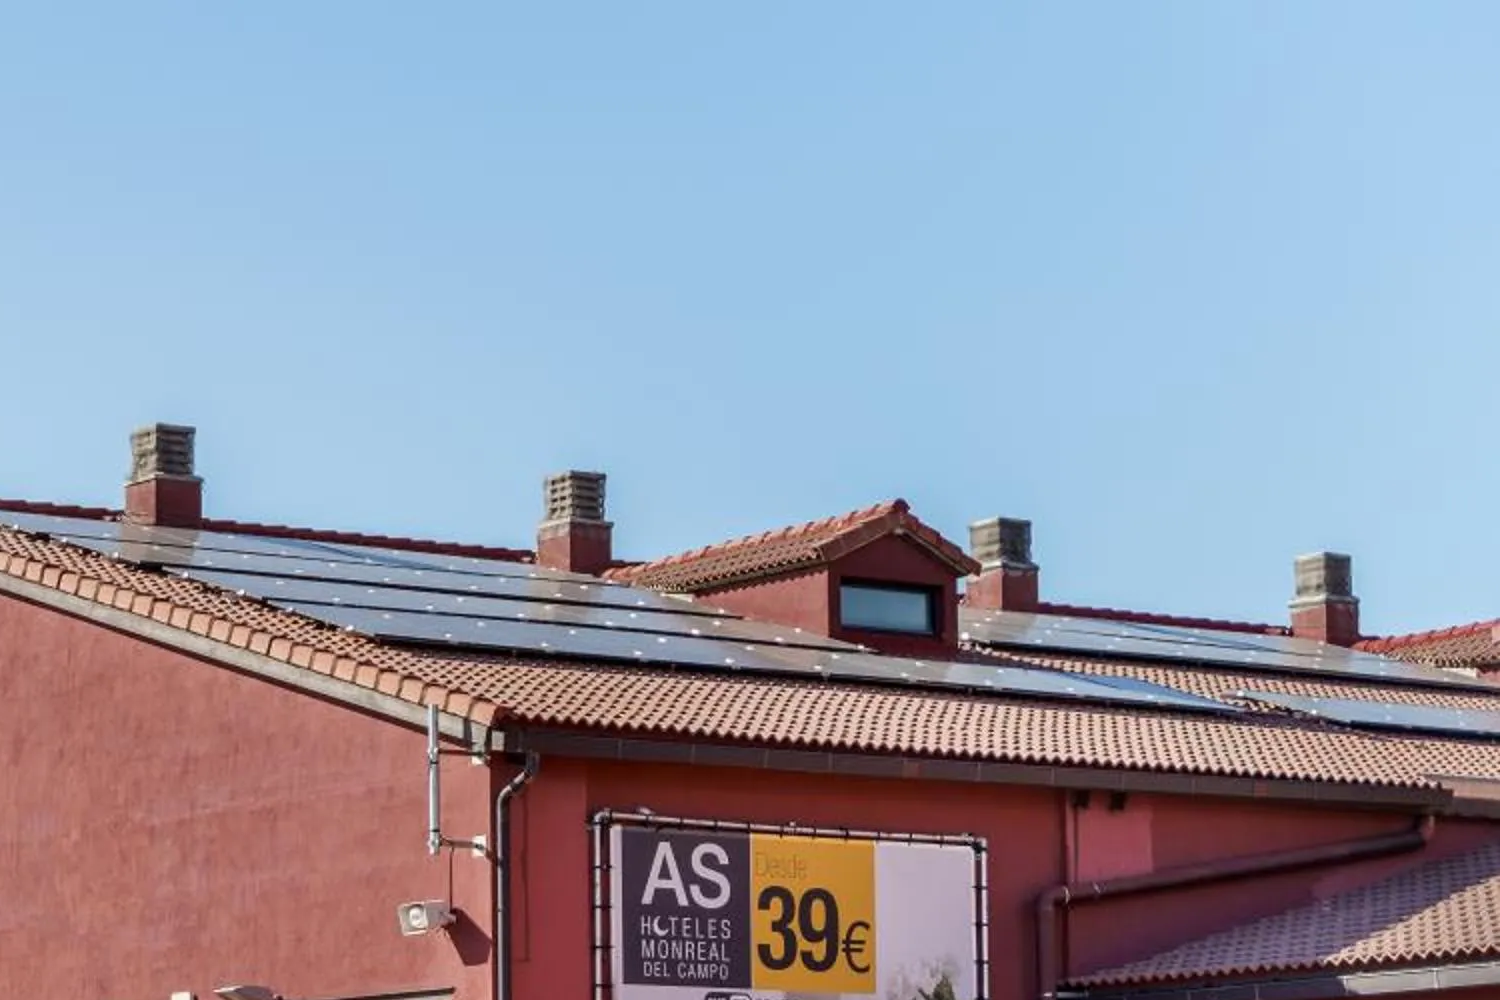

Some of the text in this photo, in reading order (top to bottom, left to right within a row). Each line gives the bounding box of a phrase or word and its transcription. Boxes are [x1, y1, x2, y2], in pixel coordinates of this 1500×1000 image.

[641, 841, 731, 909] AS
[756, 851, 808, 879] Desde
[640, 915, 732, 940] HOTELES
[757, 885, 871, 974] 39€
[641, 939, 731, 962] MONREAL
[643, 962, 729, 981] DEL CAMPO
